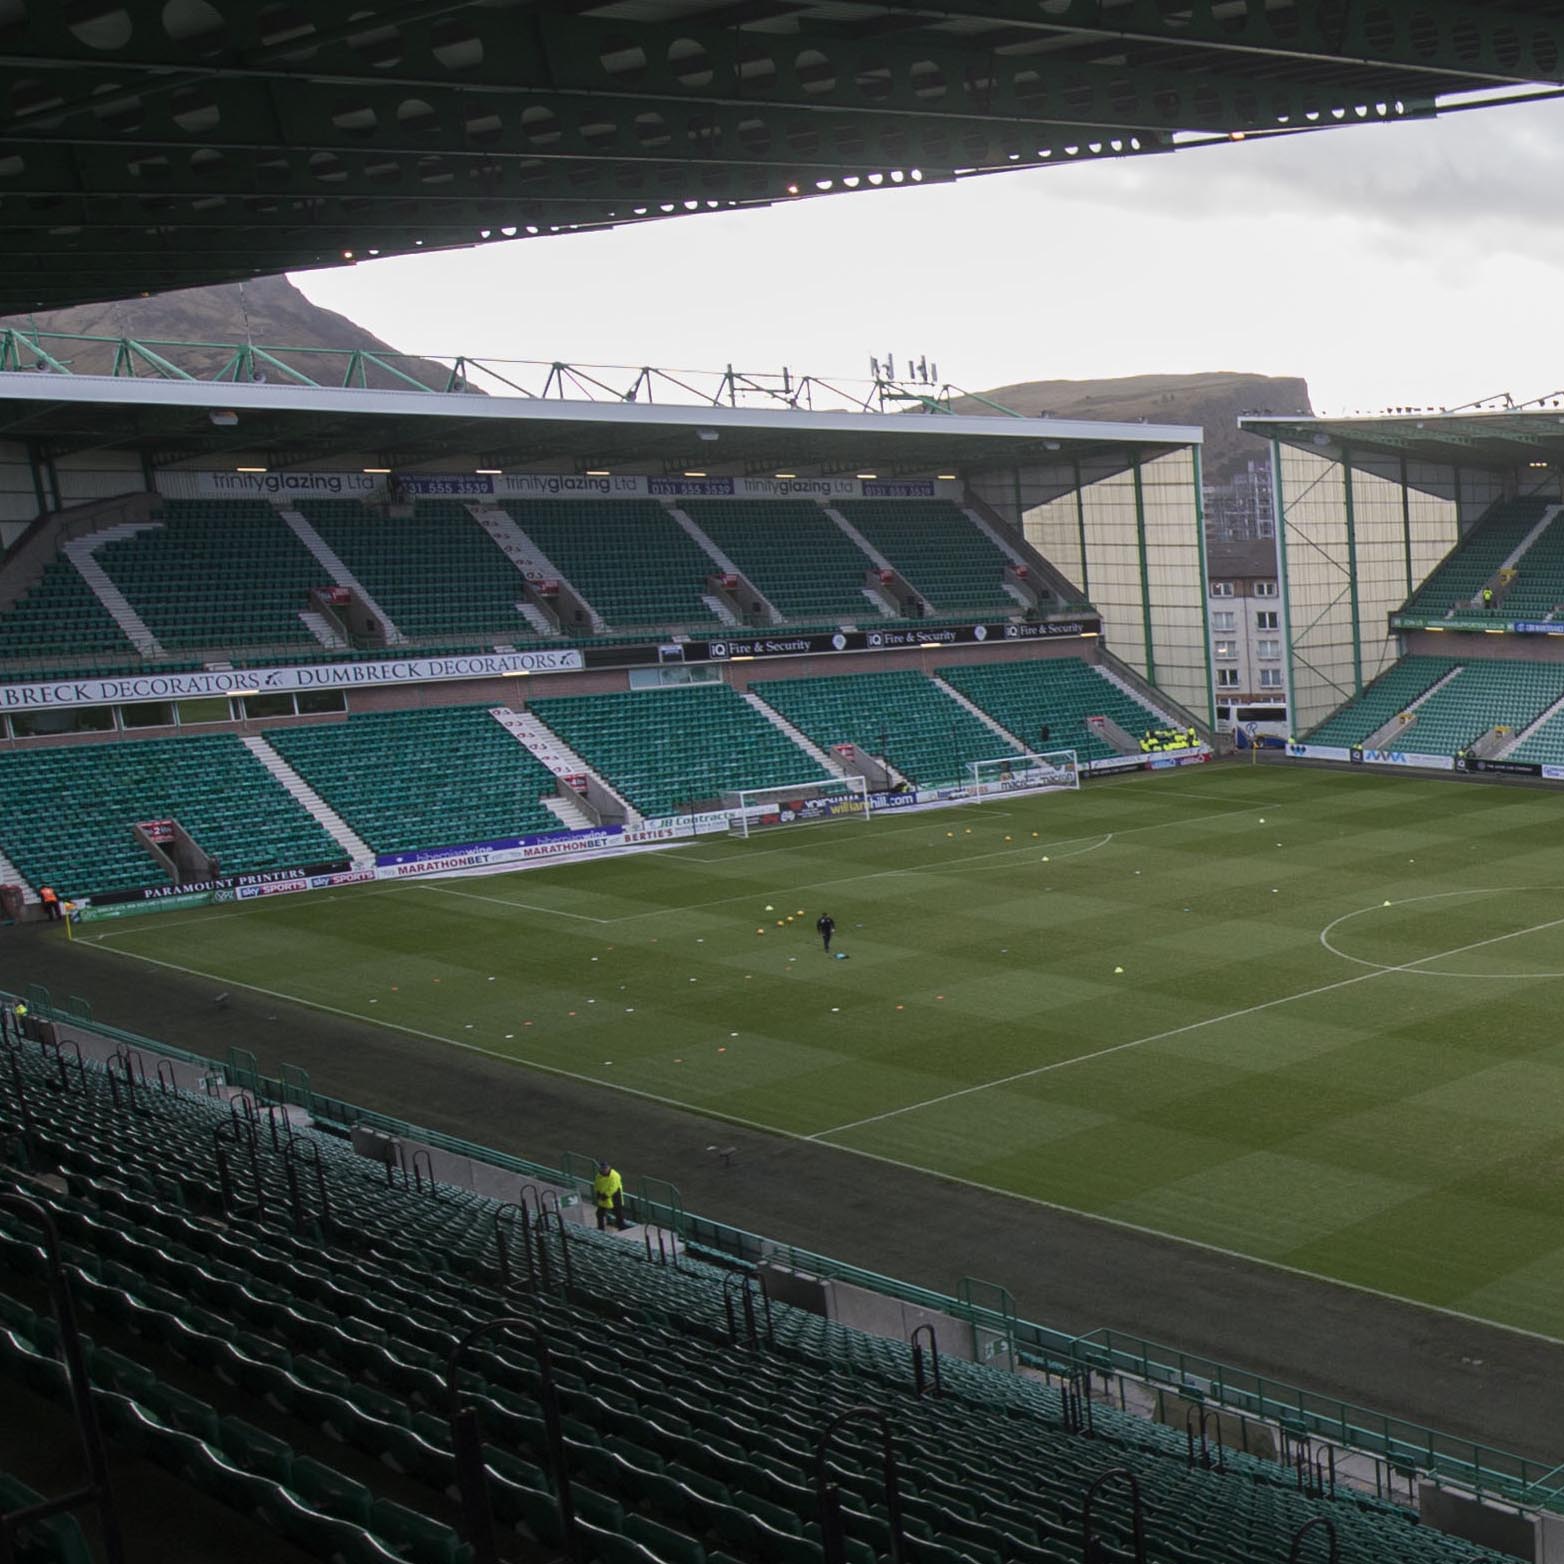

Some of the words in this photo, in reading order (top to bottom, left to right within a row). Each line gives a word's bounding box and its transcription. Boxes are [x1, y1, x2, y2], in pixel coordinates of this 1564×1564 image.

[213, 473, 343, 492] trinityglazing
[347, 475, 374, 490] Ltd
[429, 483, 452, 493] 555
[458, 483, 489, 493] 3539
[506, 476, 610, 493] trinityglazing
[615, 477, 636, 490] Ltd
[744, 480, 831, 495] trinityglazing
[834, 480, 853, 492] Ltd
[885, 634, 905, 645] Fire
[906, 633, 914, 642] &
[917, 631, 956, 643] Security
[1020, 626, 1038, 636] Fire
[1039, 626, 1046, 634] &
[1048, 624, 1084, 635] Security
[711, 644, 726, 656] iQ
[730, 643, 752, 654] Fire
[754, 642, 763, 652] &
[766, 639, 811, 653] Security
[297, 663, 422, 685] DUMBRECK
[428, 653, 556, 676] DECORATORS
[0, 685, 92, 706] BRECK
[102, 673, 259, 699] DECORATORS
[675, 811, 736, 825] Contracts
[624, 829, 673, 843] BERTIE'S
[523, 838, 607, 857] MARATHONBET
[398, 855, 490, 875] MARATHONBET
[144, 878, 234, 898] PARAMOUNT
[239, 868, 306, 886] PRINTERS
[312, 877, 330, 888] sky
[333, 870, 375, 884] SPORTS
[241, 887, 260, 899] sky
[263, 881, 307, 895] SPORTS
